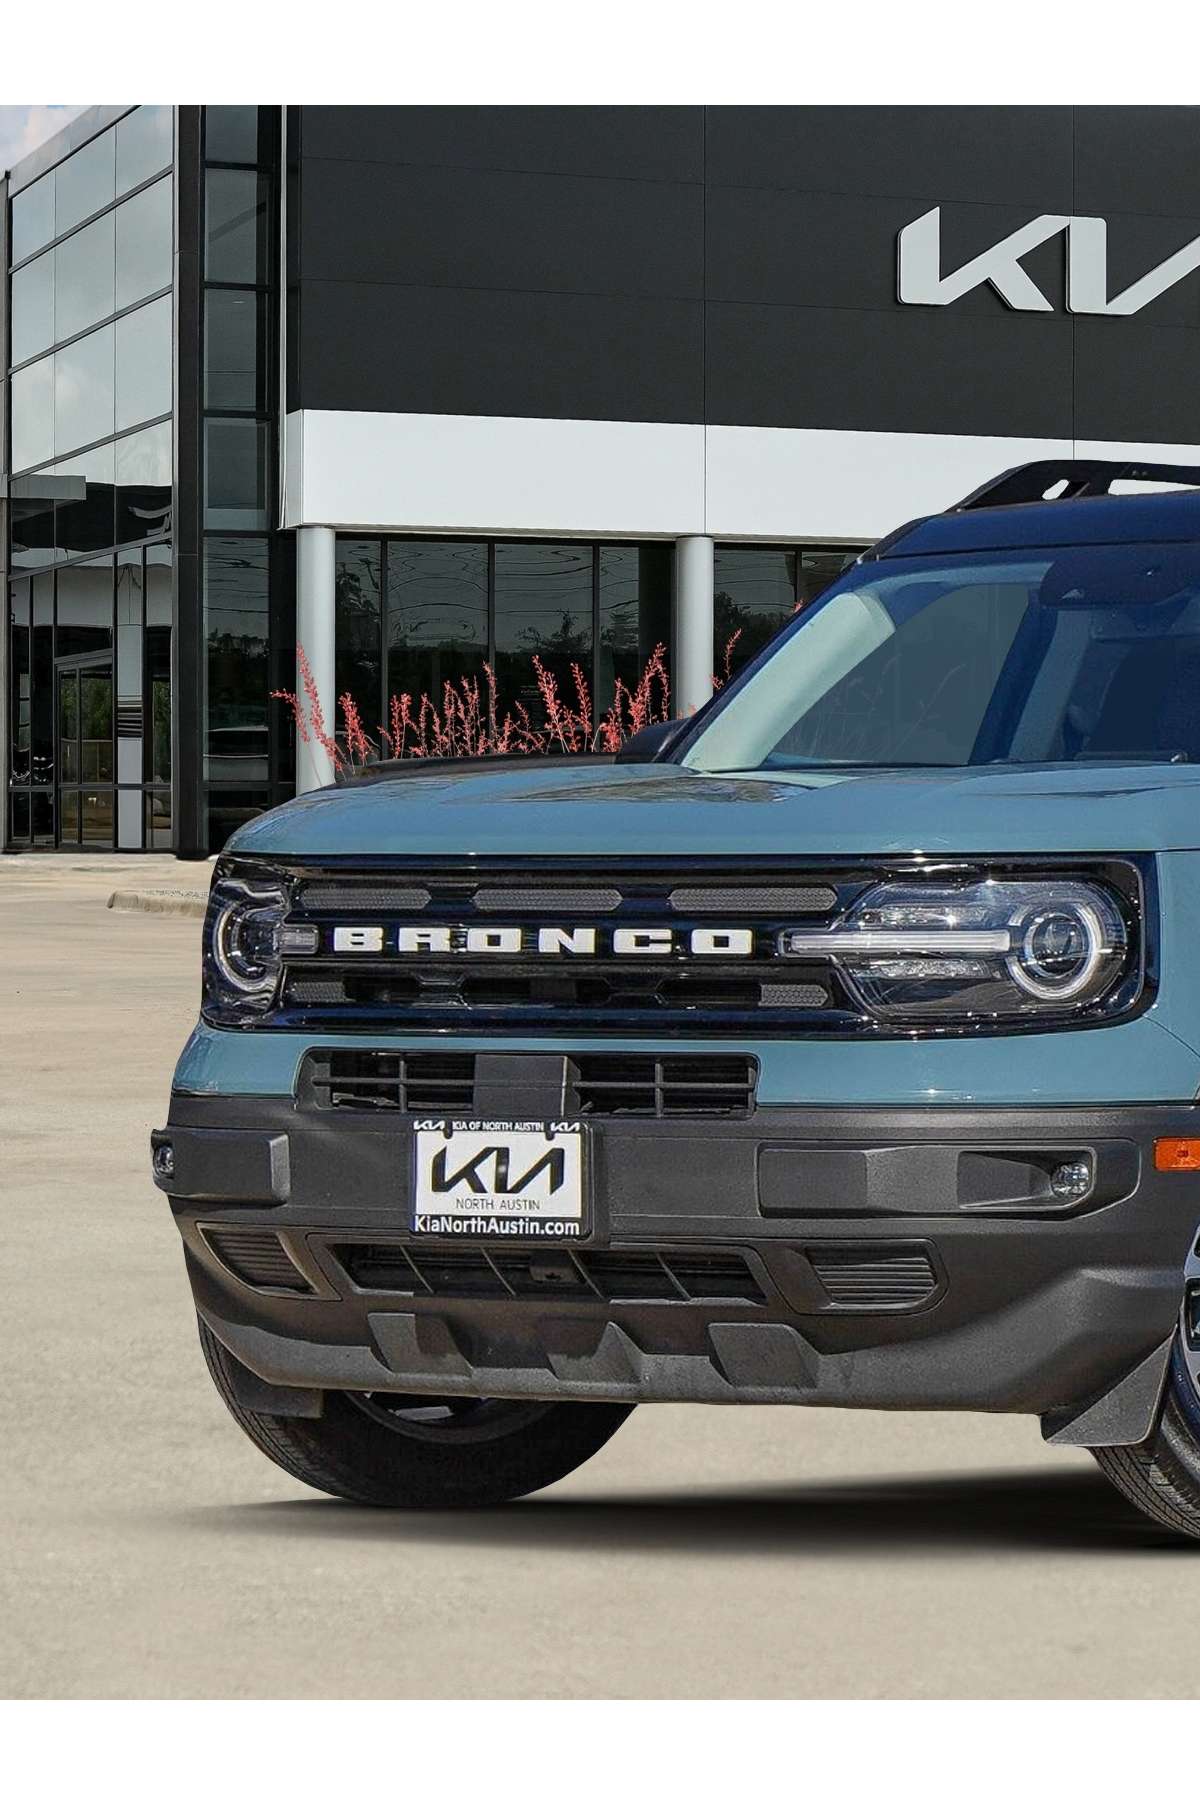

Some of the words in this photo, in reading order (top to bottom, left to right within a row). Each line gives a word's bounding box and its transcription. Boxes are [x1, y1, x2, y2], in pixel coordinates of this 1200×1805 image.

[333, 926, 754, 955] BRONCO
[452, 1121, 468, 1131] KIA
[468, 1121, 481, 1131] OF
[482, 1121, 513, 1132] NORTH
[514, 1121, 544, 1132] AUSTIN
[431, 1145, 566, 1195] KIA
[455, 1198, 495, 1211] NORTH
[499, 1199, 541, 1211] AUSTIN
[414, 1214, 580, 1236] KiaNorthAustin.com
